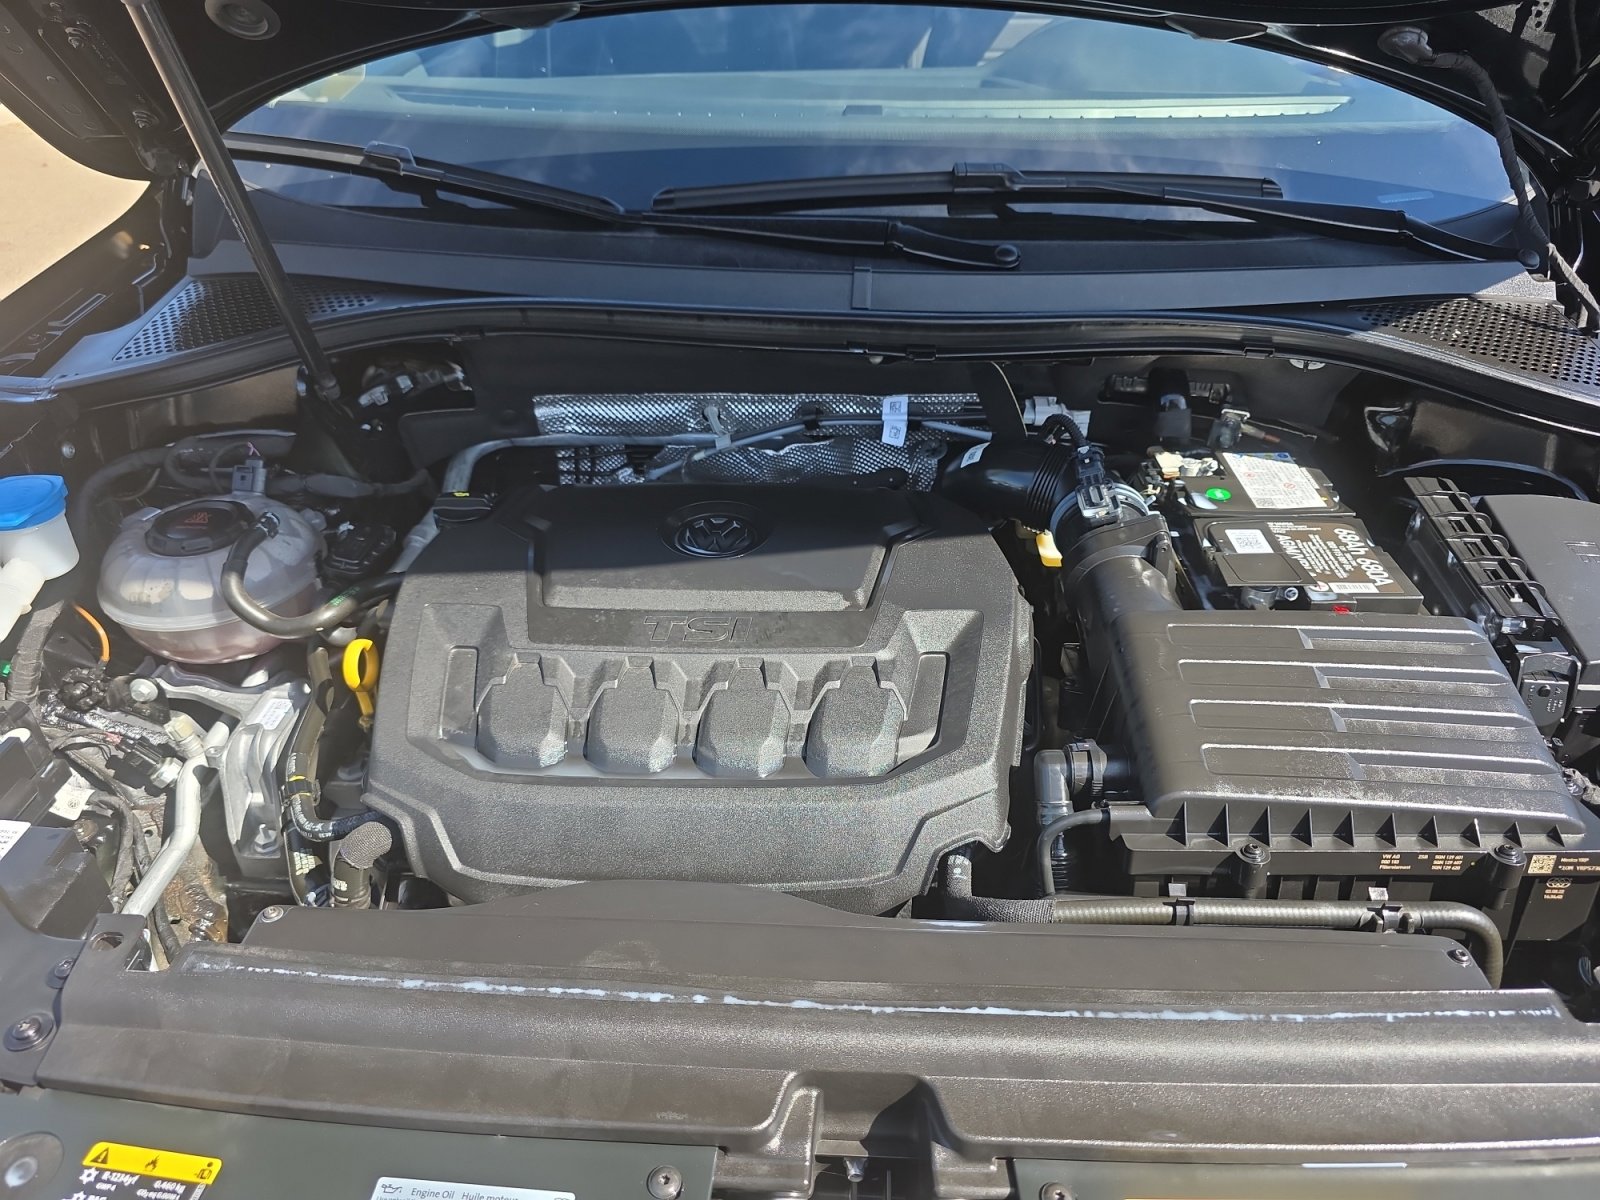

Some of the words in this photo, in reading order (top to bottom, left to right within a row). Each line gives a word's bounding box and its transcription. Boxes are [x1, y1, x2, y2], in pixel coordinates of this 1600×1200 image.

[1334, 528, 1368, 555] 68Ah
[1356, 558, 1394, 586] 680A
[644, 616, 752, 642] TSI
[411, 1187, 440, 1199] Engine
[442, 1190, 455, 1199] Oil
[461, 1191, 484, 1200] Huile
